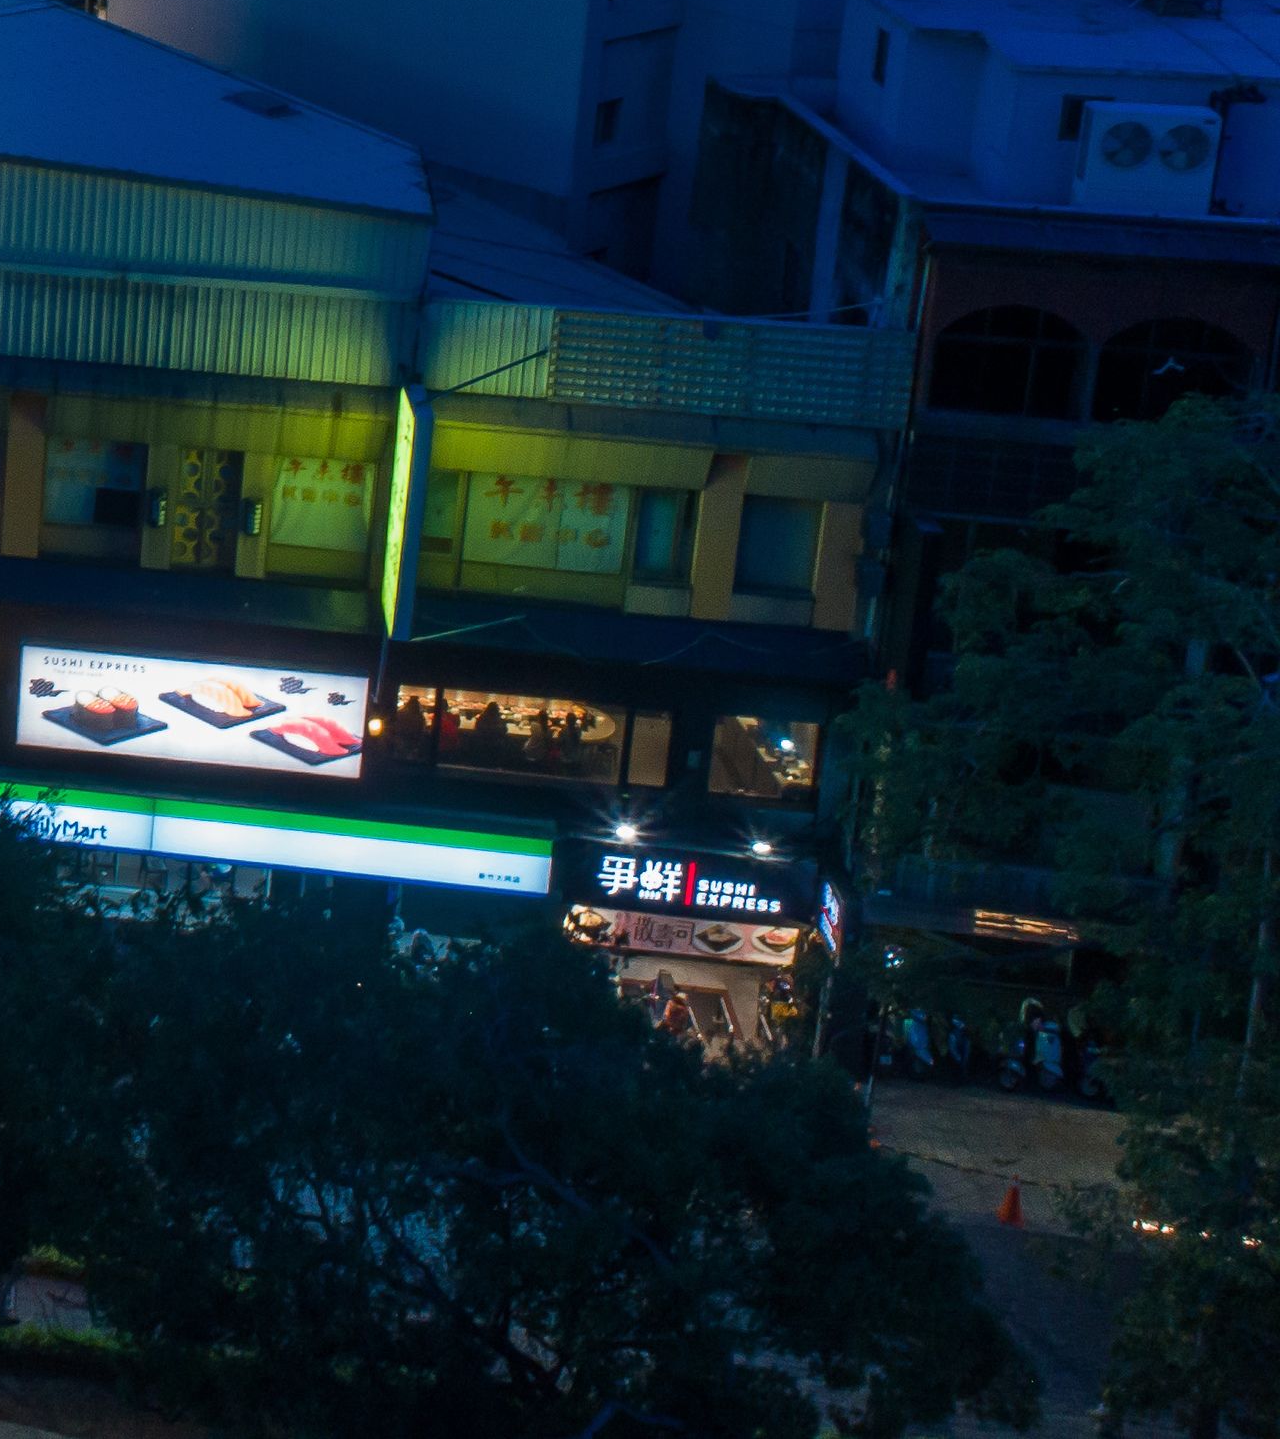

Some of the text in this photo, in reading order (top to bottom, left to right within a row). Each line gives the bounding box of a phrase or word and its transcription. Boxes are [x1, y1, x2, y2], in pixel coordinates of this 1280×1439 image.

[43, 655, 83, 668] SUSHI
[89, 660, 147, 674] EXPRESS
[696, 878, 756, 897] SUSHI
[695, 892, 782, 913] EXPRESS
